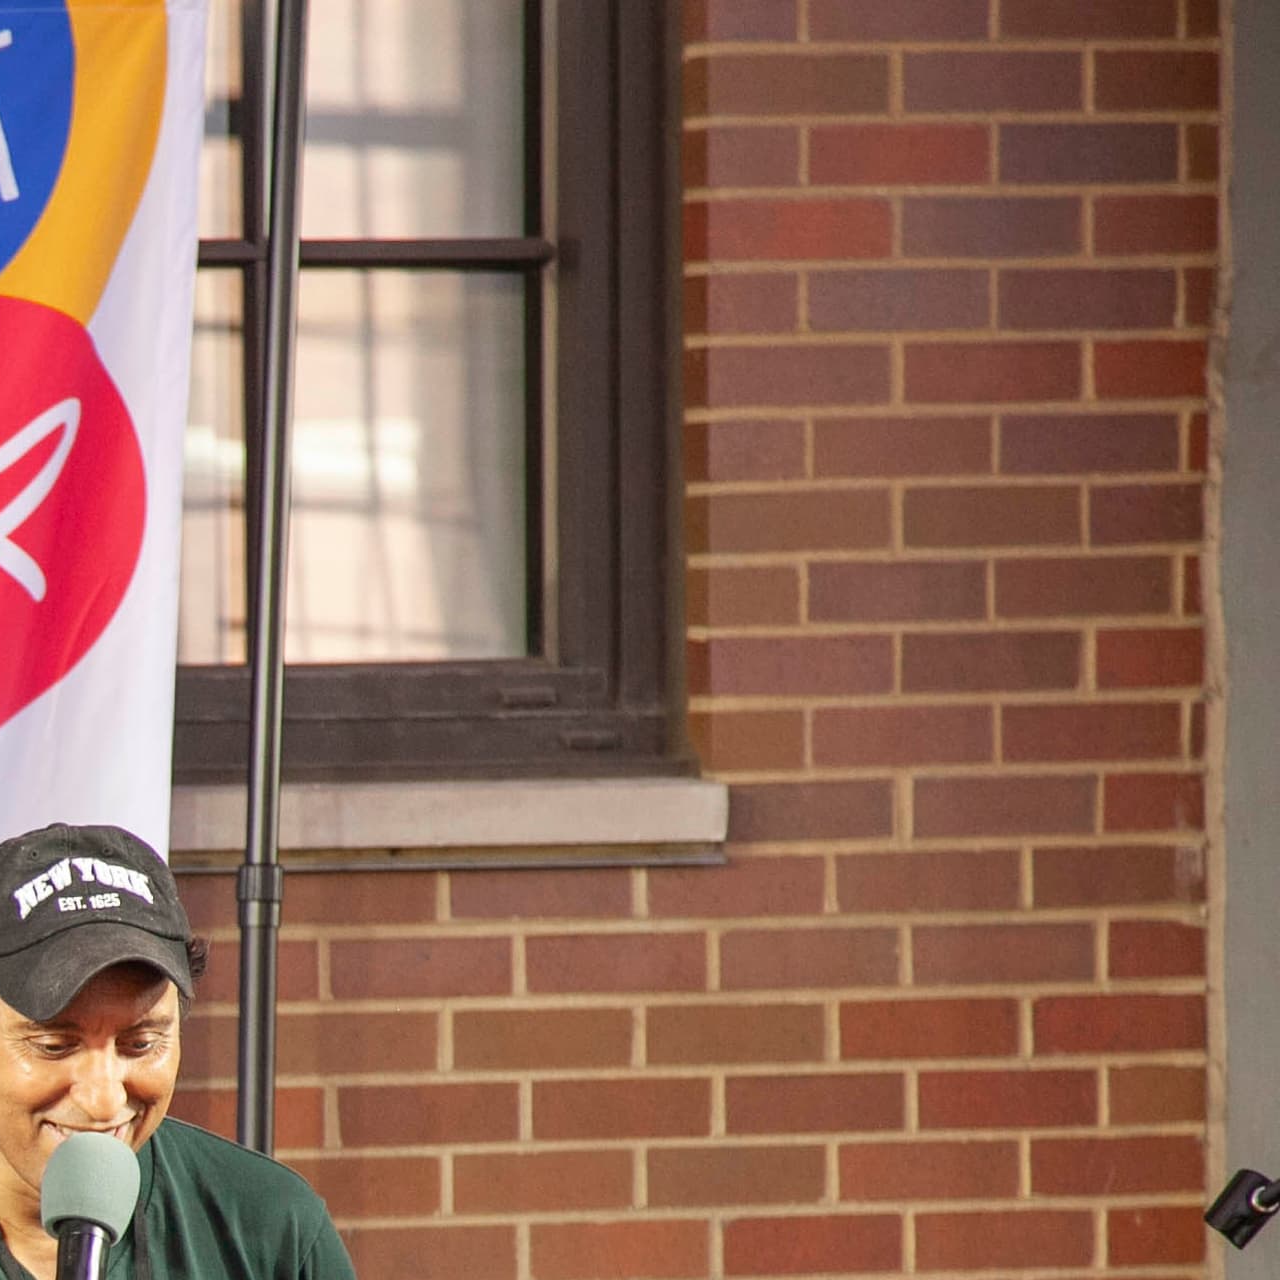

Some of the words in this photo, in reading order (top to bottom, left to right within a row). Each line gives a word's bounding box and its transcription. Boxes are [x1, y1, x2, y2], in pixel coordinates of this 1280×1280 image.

[13, 857, 72, 920] NEW
[71, 857, 154, 904] YORK
[57, 896, 87, 912] EST.
